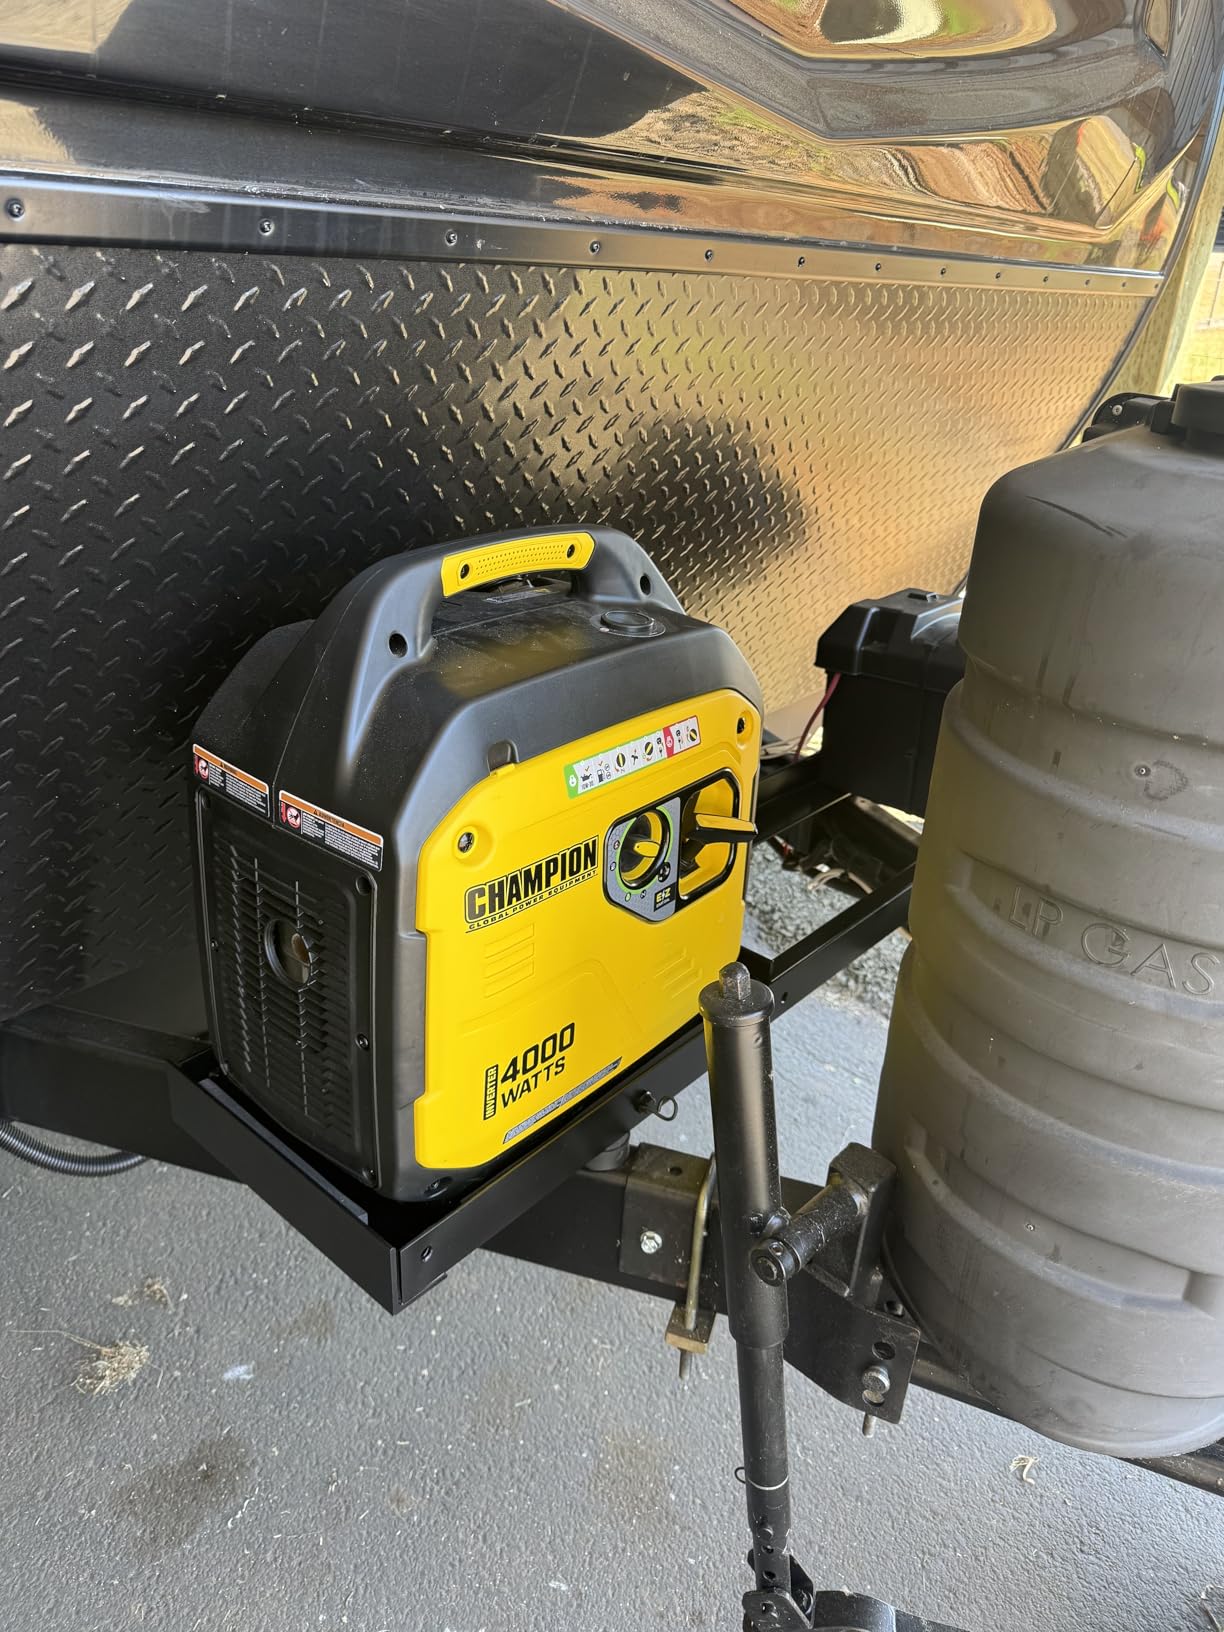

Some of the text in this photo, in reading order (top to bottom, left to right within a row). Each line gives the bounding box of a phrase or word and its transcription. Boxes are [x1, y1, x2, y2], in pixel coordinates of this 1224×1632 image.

[466, 838, 598, 920] CHAMPION
[469, 869, 598, 930] GLOBAL POWER EQUIPMENT
[1008, 886, 1221, 995] LP GAS
[500, 1022, 576, 1084] 4000
[501, 1056, 566, 1109] WATTS
[485, 1066, 498, 1119] INVERTER
